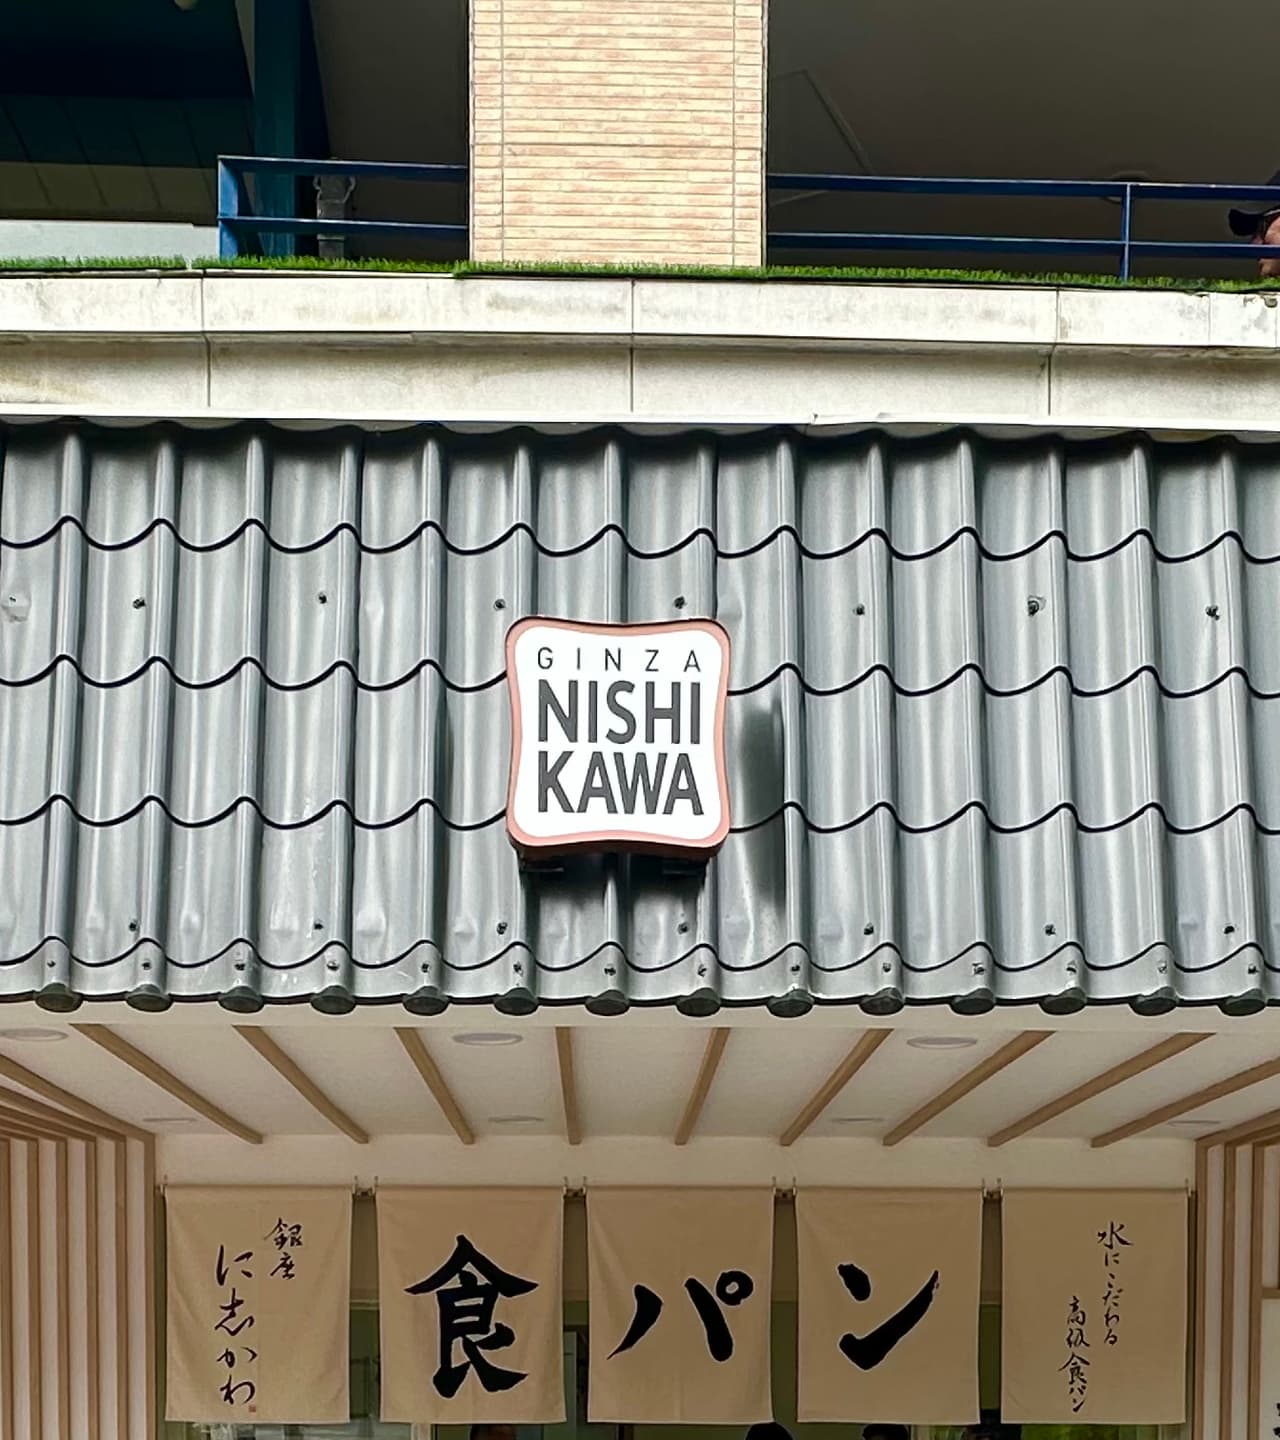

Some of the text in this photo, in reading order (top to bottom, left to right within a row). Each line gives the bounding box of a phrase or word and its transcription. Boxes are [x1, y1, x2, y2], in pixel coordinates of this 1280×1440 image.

[536, 646, 702, 673] GINZA
[537, 678, 701, 745] NISHI
[537, 750, 704, 816] KAWA
[264, 1217, 303, 1281] 銀座
[403, 1234, 940, 1398] 食パン
[1097, 1220, 1134, 1346] 水にこだわる
